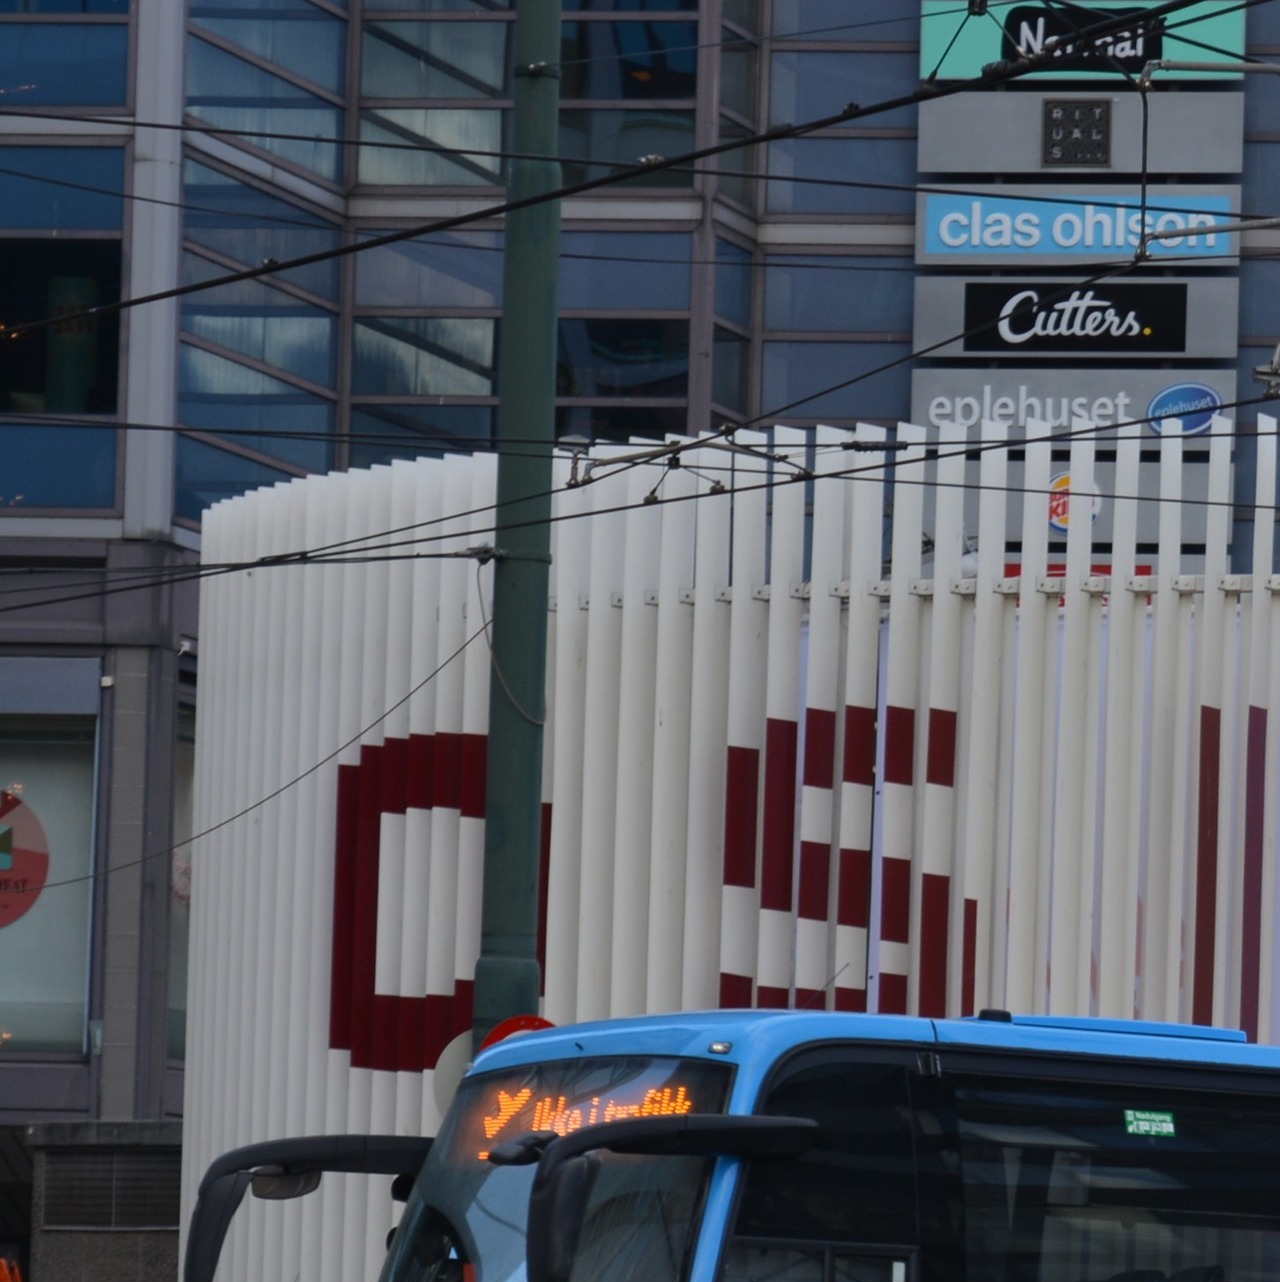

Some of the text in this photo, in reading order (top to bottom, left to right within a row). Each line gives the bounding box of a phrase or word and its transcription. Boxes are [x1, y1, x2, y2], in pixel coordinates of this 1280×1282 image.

[938, 202, 1216, 249] clas ohlson
[929, 385, 1131, 428] eplehuset
